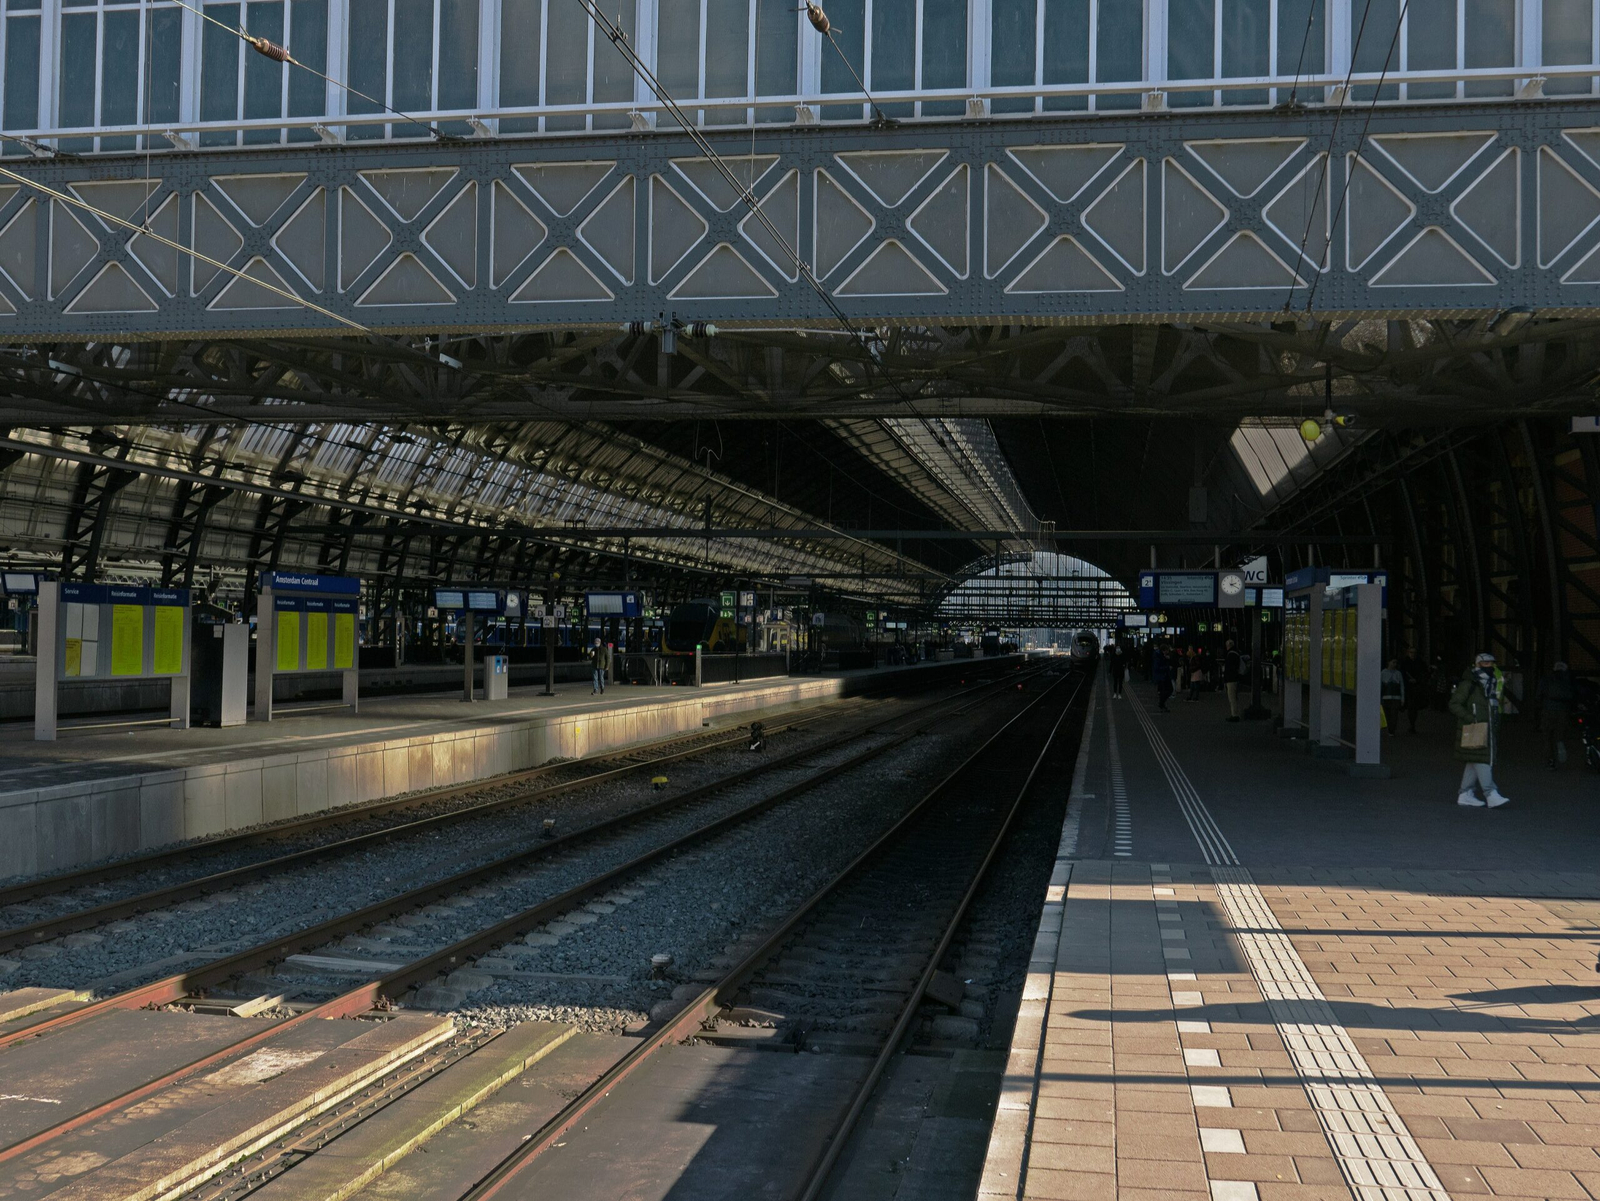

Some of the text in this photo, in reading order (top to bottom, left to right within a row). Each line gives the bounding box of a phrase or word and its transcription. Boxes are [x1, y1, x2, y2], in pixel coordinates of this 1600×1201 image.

[1244, 570, 1265, 581] WC
[275, 575, 319, 586] Amsterdam Centraal
[111, 590, 137, 598] Reisinformatie
[153, 592, 177, 600] Reisinformatie
